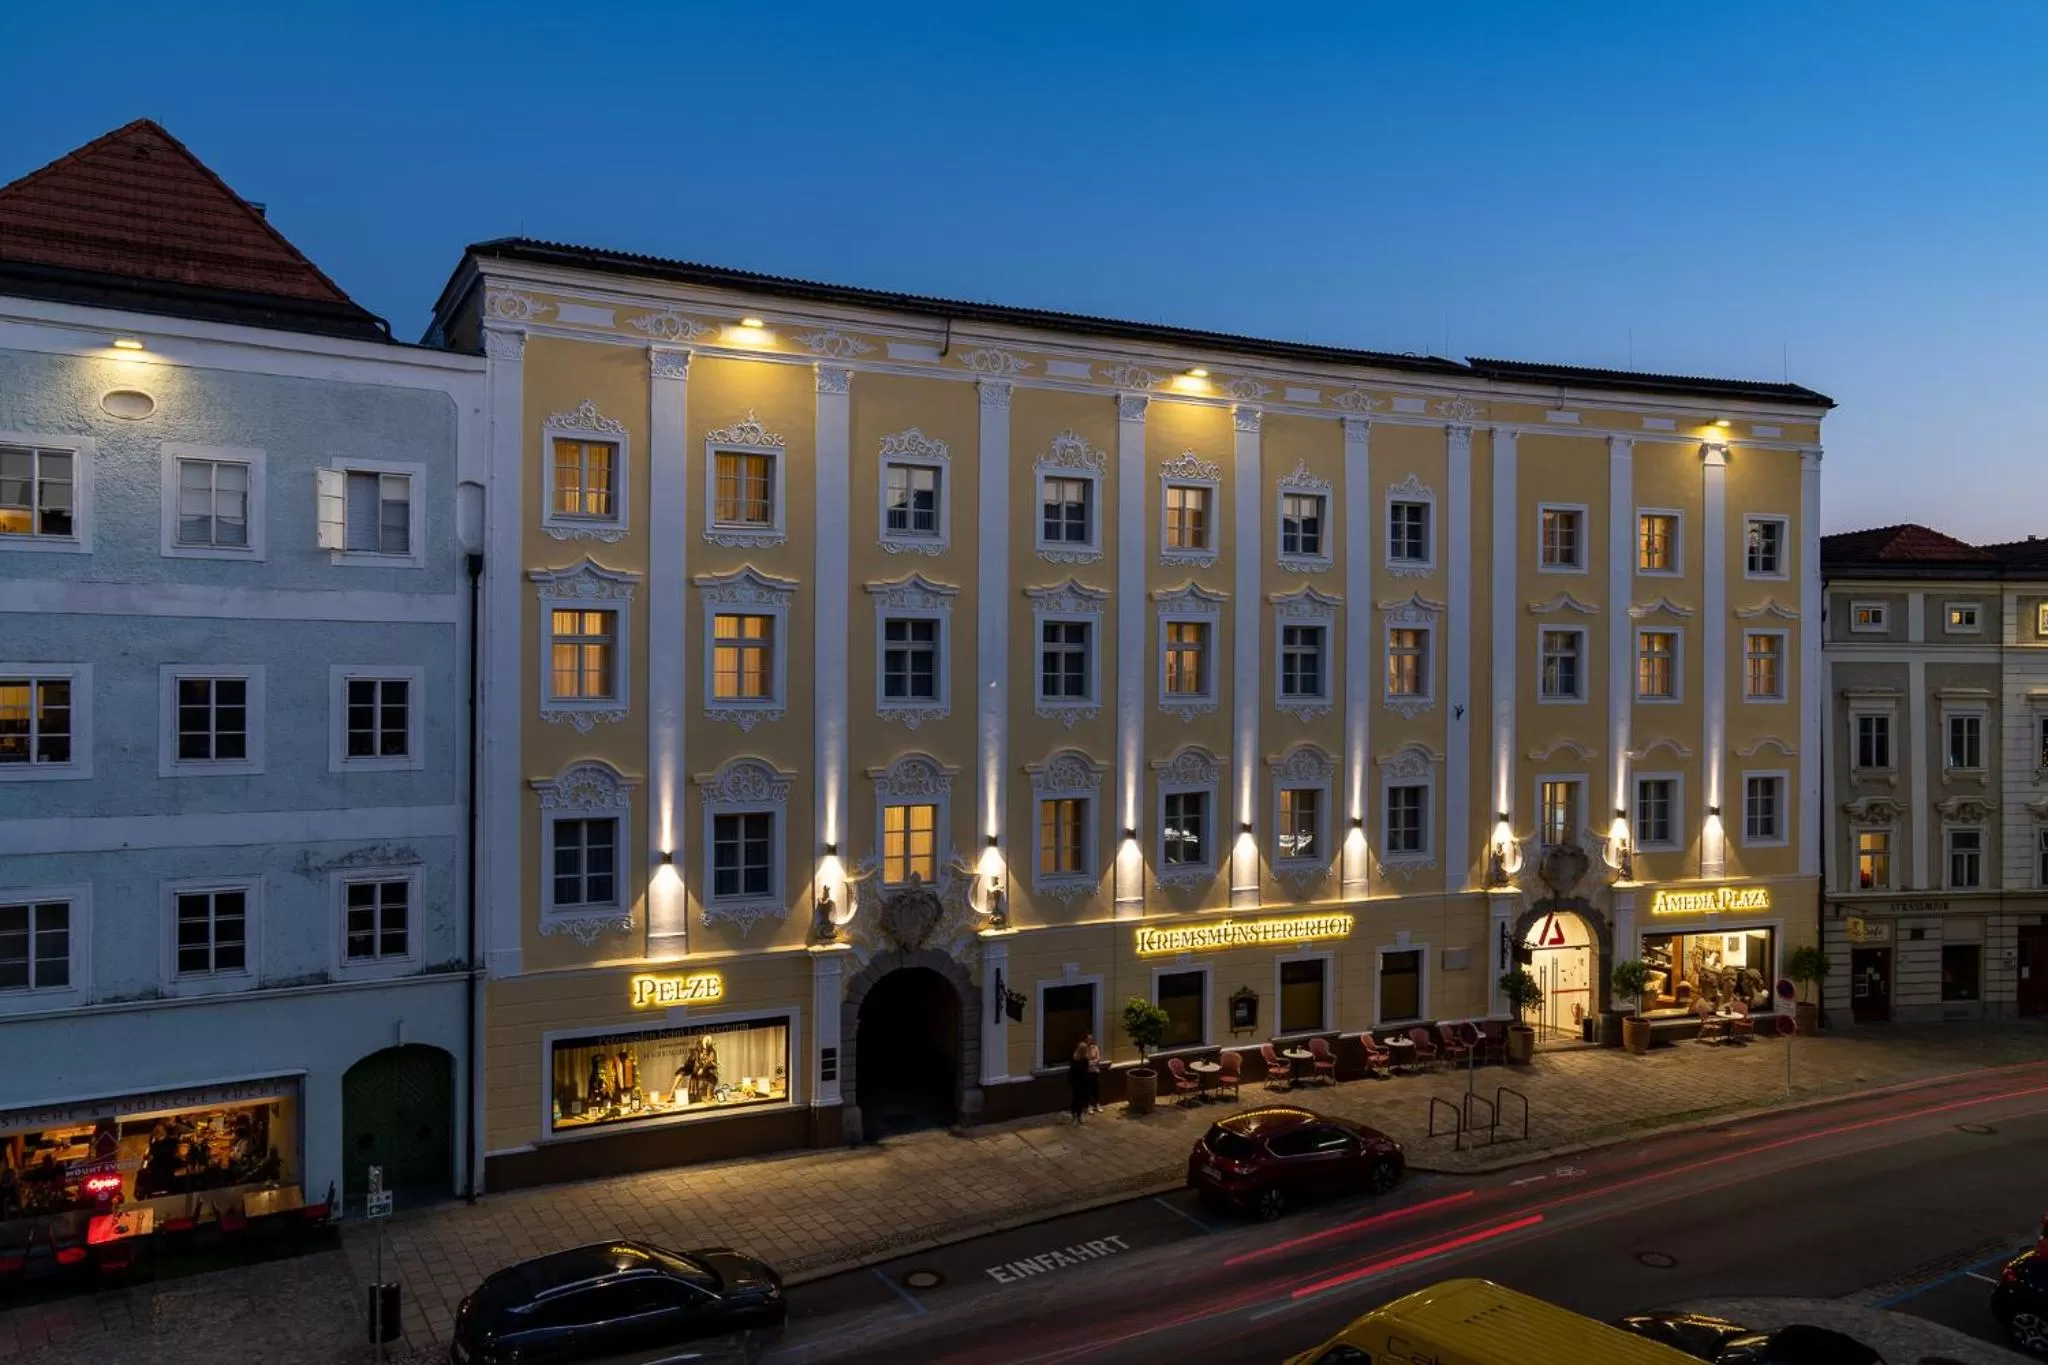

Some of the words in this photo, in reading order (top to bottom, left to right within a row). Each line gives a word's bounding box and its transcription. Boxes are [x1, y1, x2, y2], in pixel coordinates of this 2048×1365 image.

[1655, 890, 1717, 913] AMEDIA
[1719, 887, 1769, 909] PLAZA
[1138, 915, 1354, 953] KREMSMÜNSTERERHOF
[635, 978, 720, 1004] PELZE
[114, 1092, 207, 1113] INDISCHE
[221, 1084, 281, 1101] KÜCHE
[985, 1235, 1130, 1283] EINFAHRT
